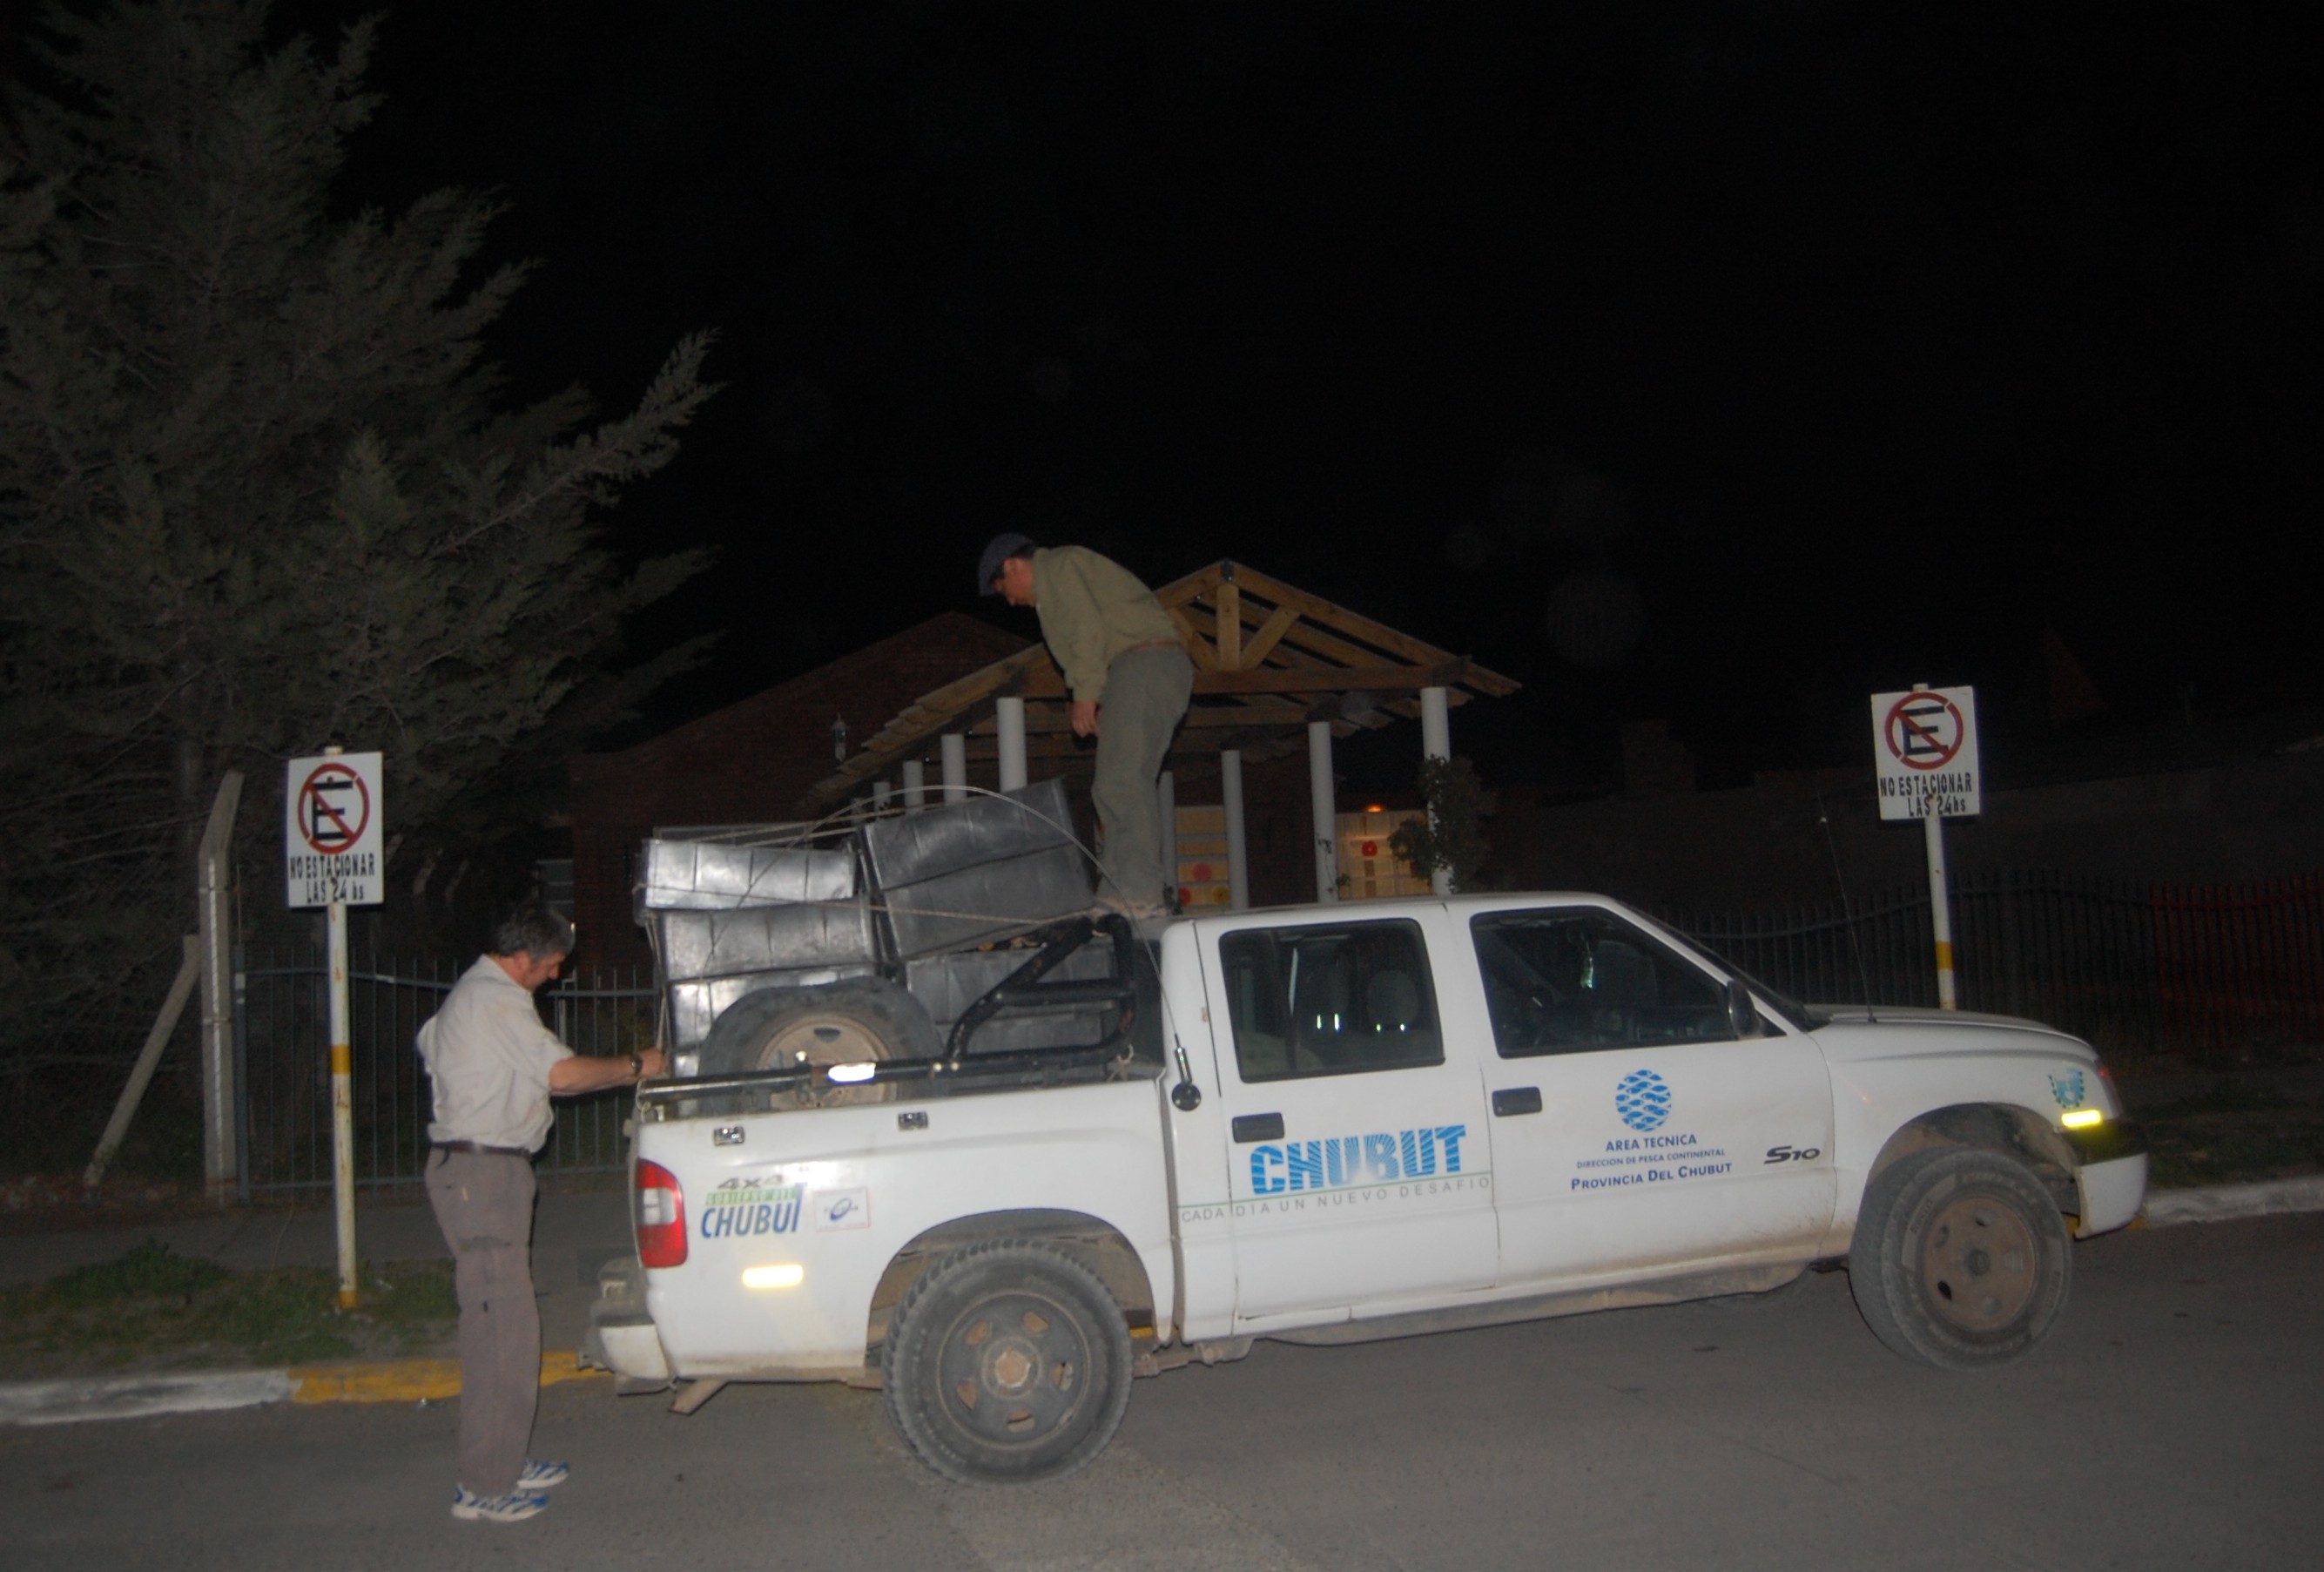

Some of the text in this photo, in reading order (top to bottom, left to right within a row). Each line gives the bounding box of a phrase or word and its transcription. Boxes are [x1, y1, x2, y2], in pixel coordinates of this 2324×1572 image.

[1880, 773, 1972, 797] NO ESTACIONAR
[1908, 796, 1930, 817] LAS
[290, 853, 374, 880] NO ESTACIONAR
[306, 879, 327, 903] LAS
[1605, 1134, 1697, 1152] AREA TECNICA
[1763, 1145, 1821, 1164] S10
[1250, 1124, 1466, 1196] CHUBUT
[1577, 1149, 1725, 1169] DIRECCION DE PESCA CONTINENTAL
[1571, 1163, 1733, 1191] PROVINCIA DEL CHUBUT
[701, 1182, 808, 1238] CHUBUT
[1181, 1177, 1490, 1224] CADA DIA UN NUEVO DESAFIO
